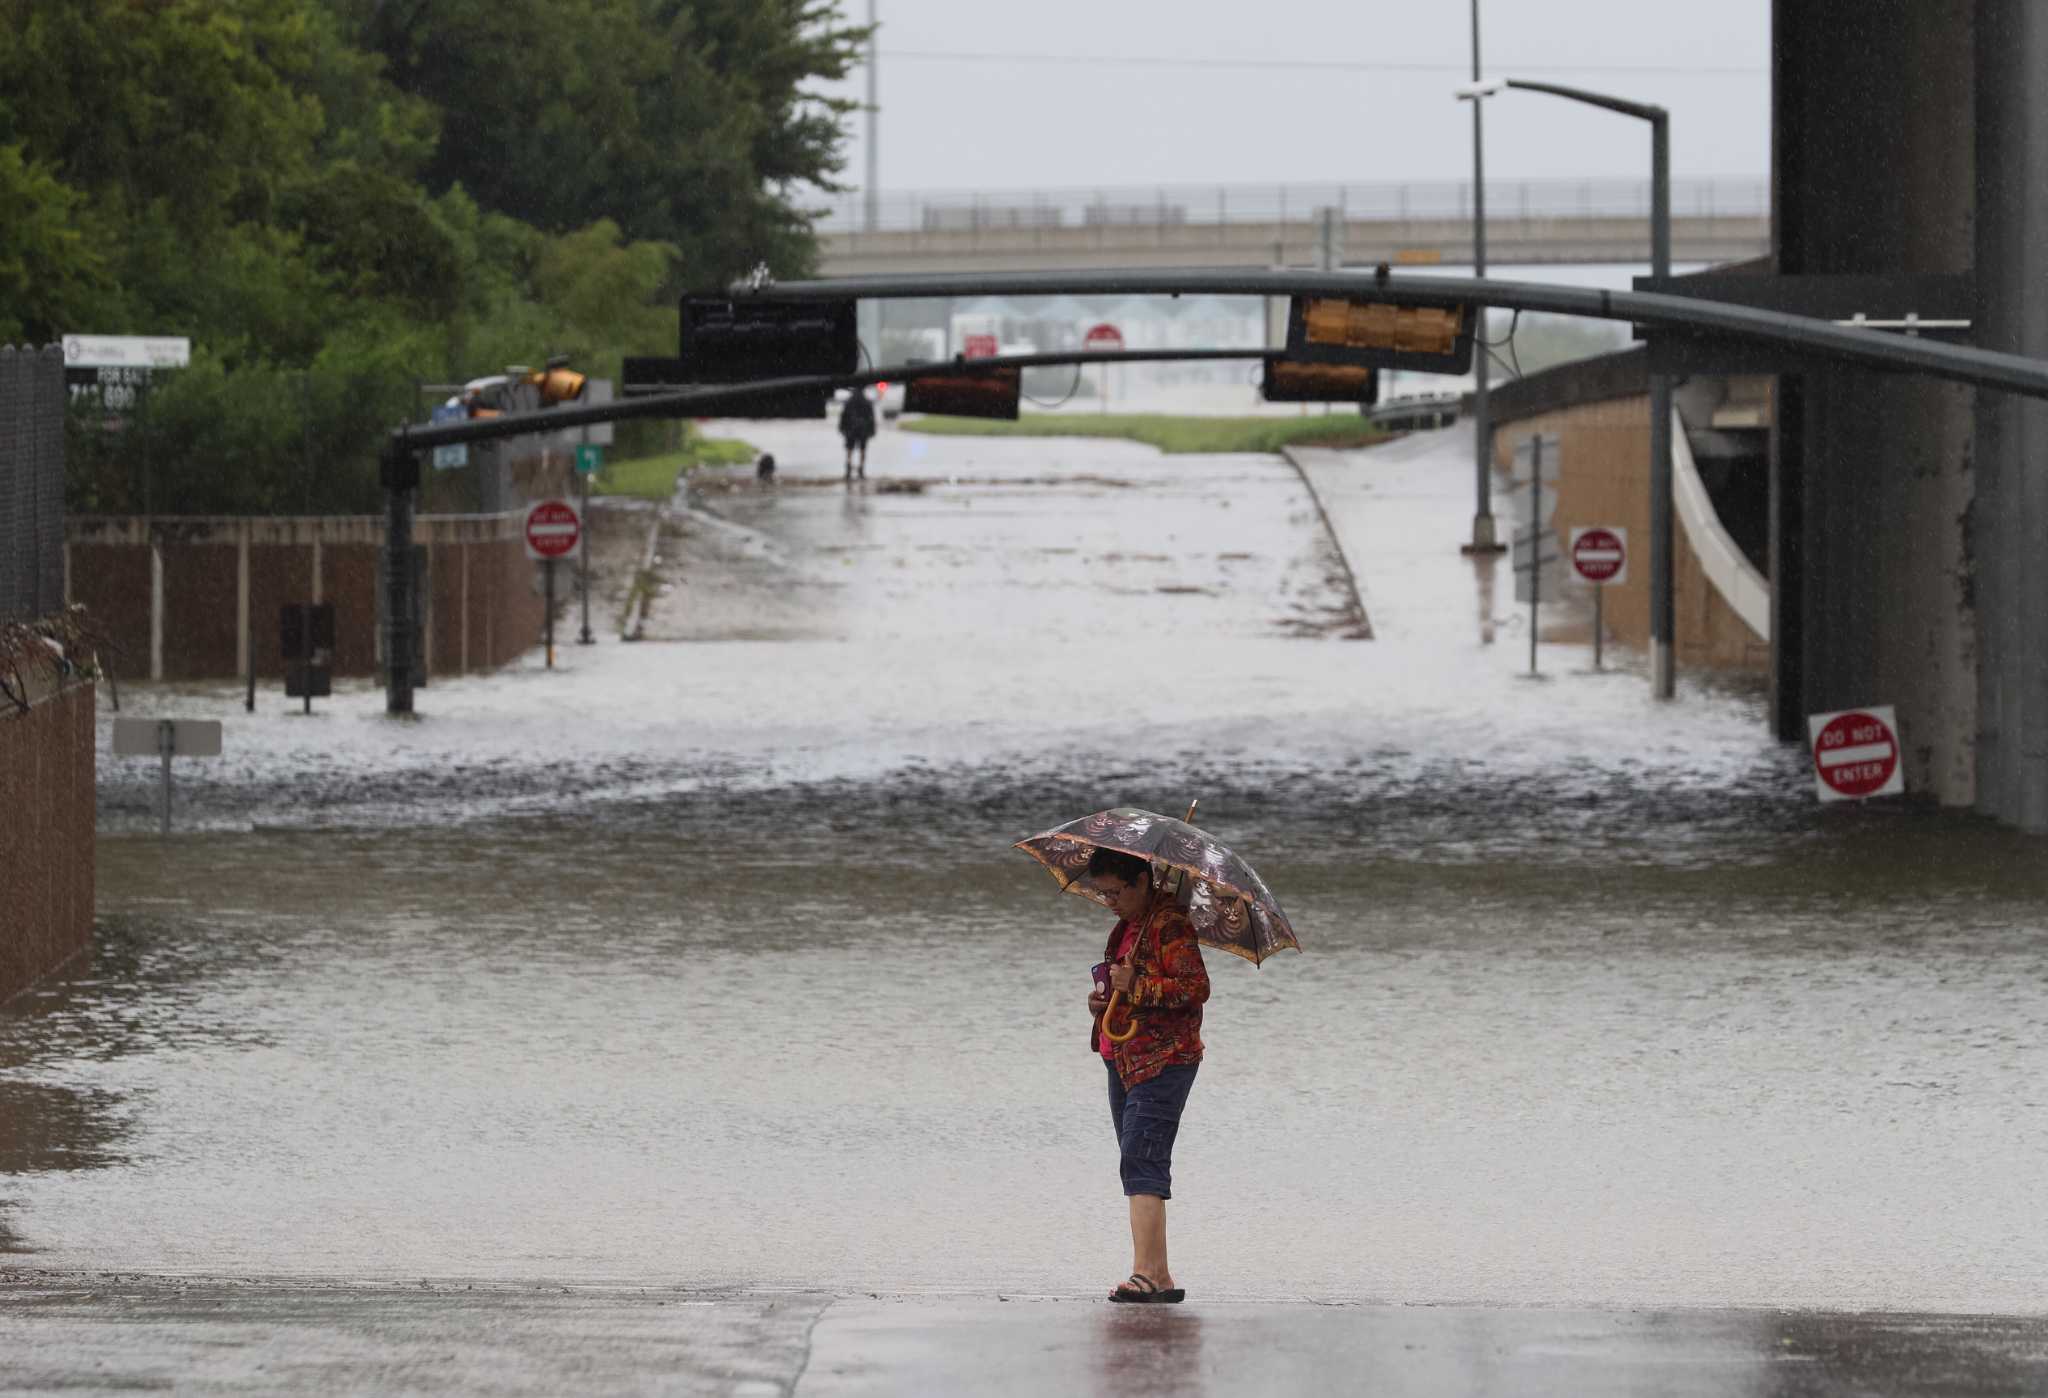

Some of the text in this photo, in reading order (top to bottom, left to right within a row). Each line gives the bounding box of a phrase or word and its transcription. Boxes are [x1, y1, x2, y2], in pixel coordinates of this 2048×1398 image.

[1823, 723, 1884, 747] DO NOT
[1833, 762, 1882, 785] ENTER
